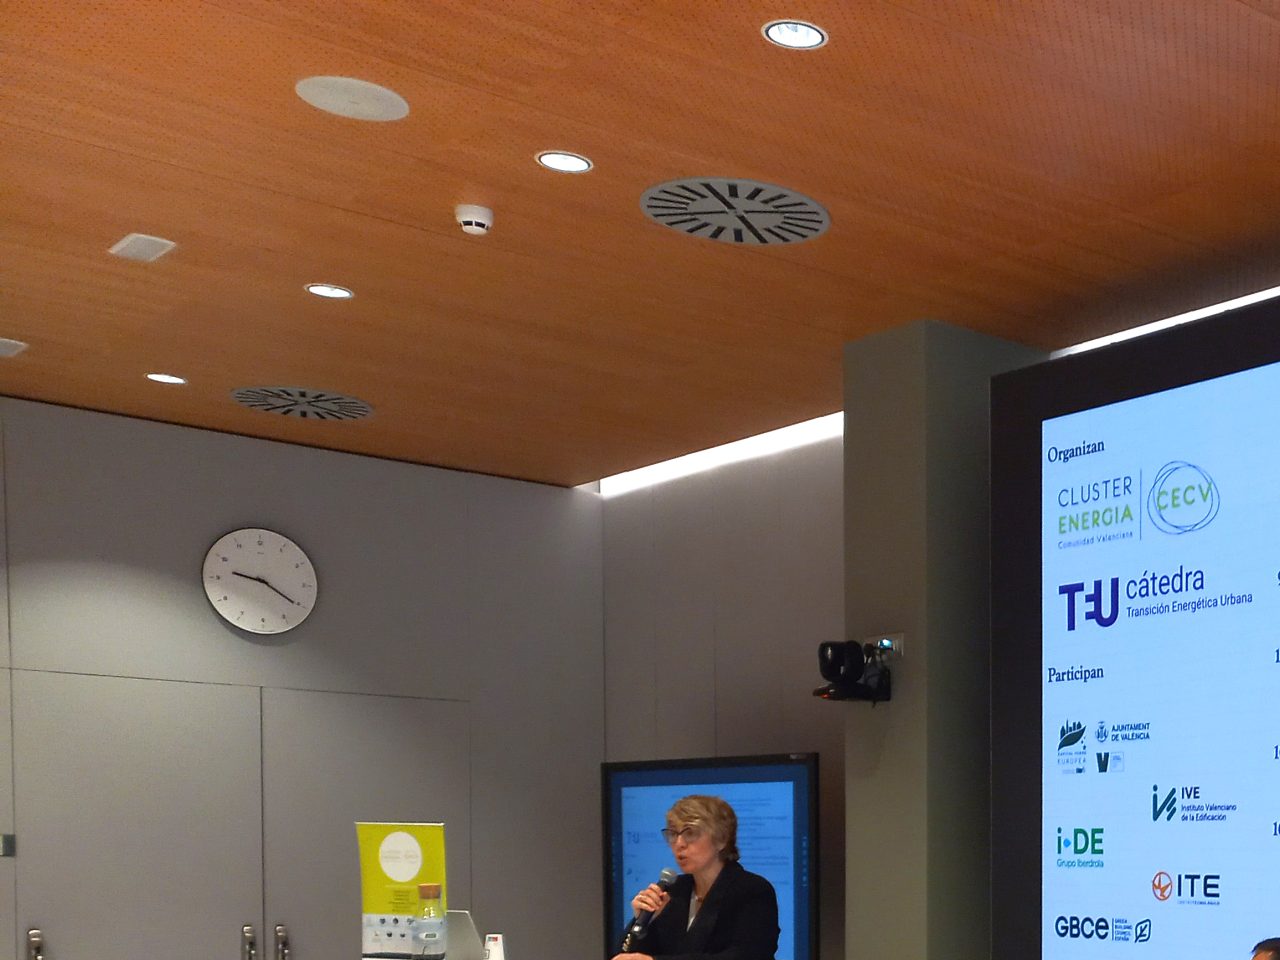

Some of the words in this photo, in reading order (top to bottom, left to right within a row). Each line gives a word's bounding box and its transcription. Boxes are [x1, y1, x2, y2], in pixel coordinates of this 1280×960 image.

[1047, 440, 1105, 463] Organizan
[1058, 476, 1132, 507] CLUSTER
[1157, 482, 1212, 511] CECV
[1058, 504, 1133, 534] ENERGIA
[1058, 537, 1095, 549] Comunidad
[1126, 565, 1204, 599] cátedra
[1126, 603, 1170, 618] Transición
[1172, 596, 1218, 614] Energética
[1220, 593, 1253, 606] Urbana
[1048, 665, 1104, 683] Participan
[1111, 722, 1150, 732] AJUNTAMENT
[1111, 733, 1119, 741] DE
[1181, 786, 1200, 799] IVE
[1057, 859, 1076, 868] Grupo
[1077, 859, 1104, 867] Iberdrola
[1177, 874, 1220, 898] ITE
